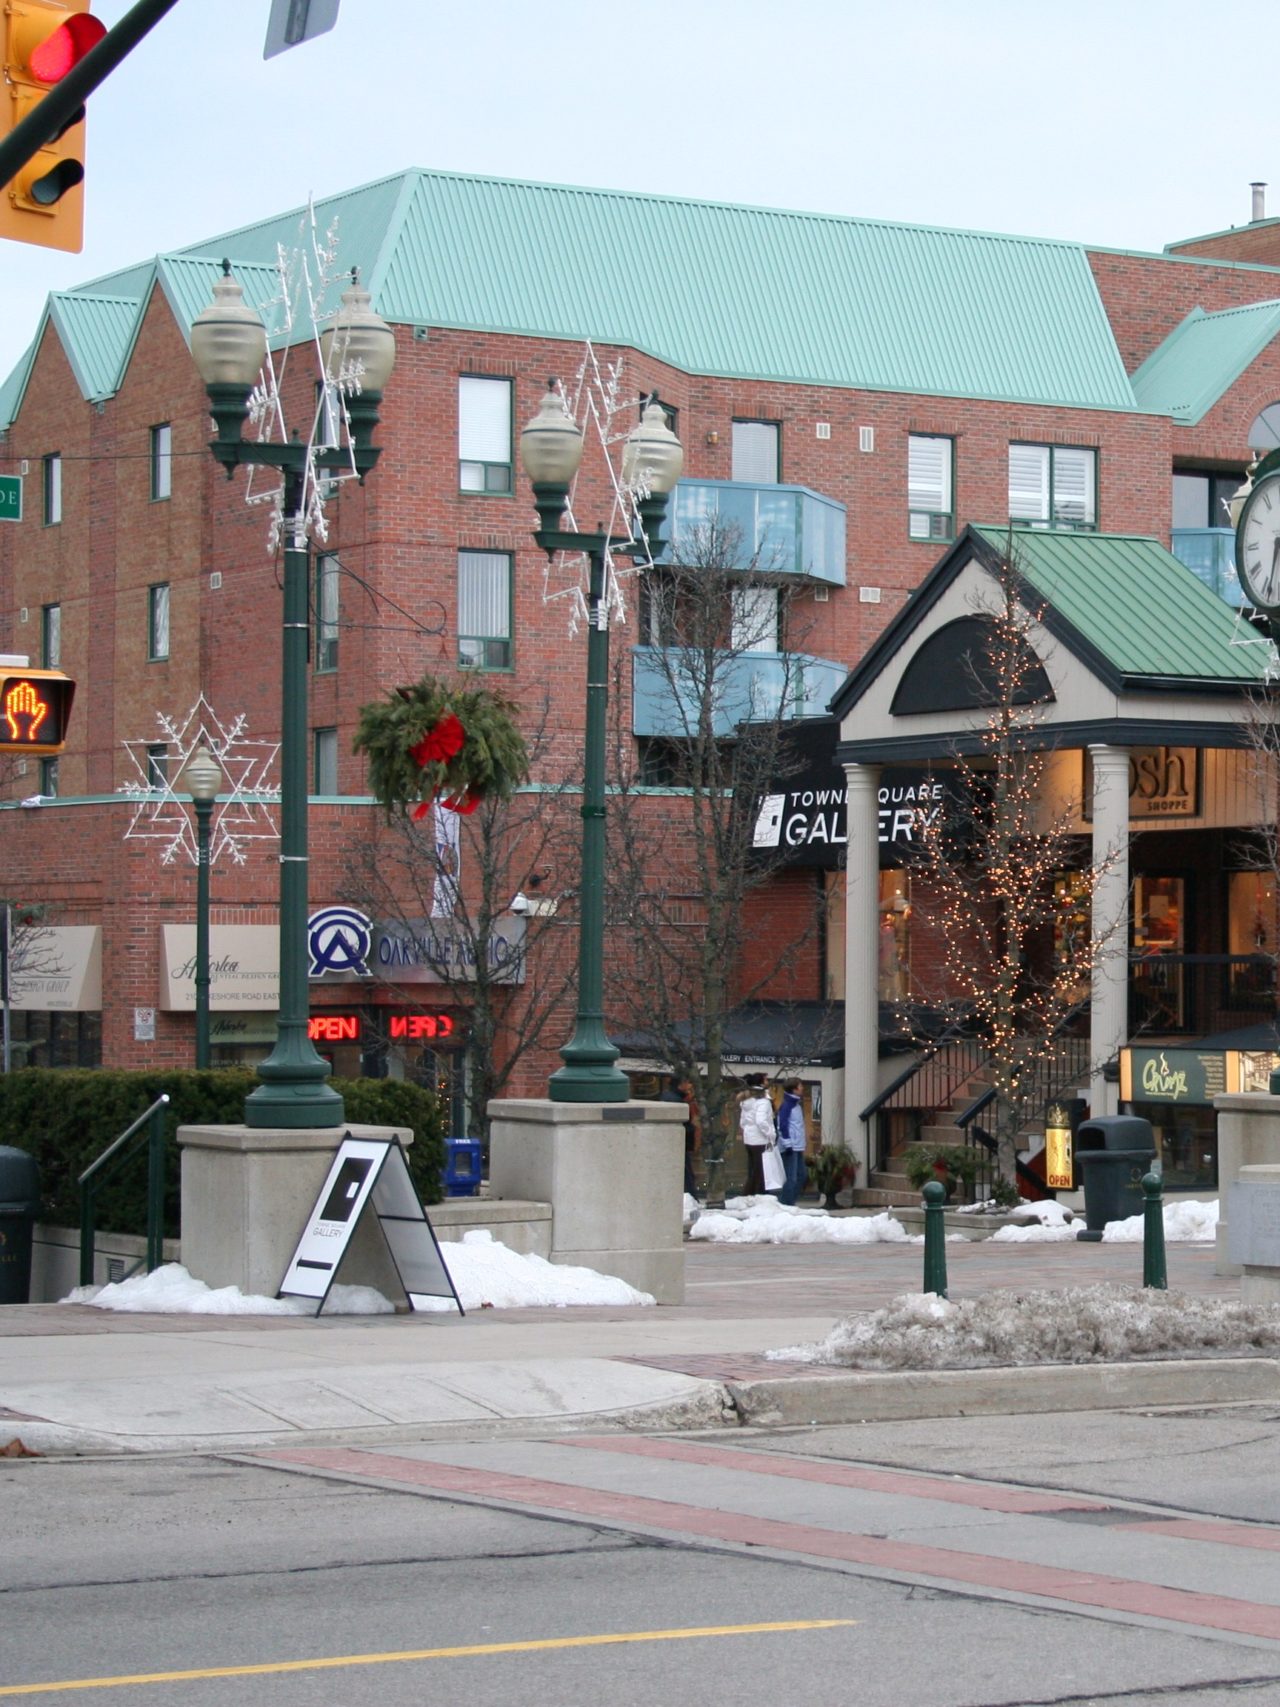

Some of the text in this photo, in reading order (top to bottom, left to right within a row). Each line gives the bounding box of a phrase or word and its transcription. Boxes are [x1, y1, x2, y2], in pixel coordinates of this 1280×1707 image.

[791, 784, 944, 807] TOWN QUARE
[1147, 801, 1187, 811] SHOPPE
[785, 807, 941, 847] GALERY
[456, 936, 509, 966] AUIO
[241, 993, 262, 1001] ROAD
[263, 993, 280, 1001] EAST
[744, 1055, 776, 1063] ENTRANCE
[1048, 1175, 1070, 1186] OPEN
